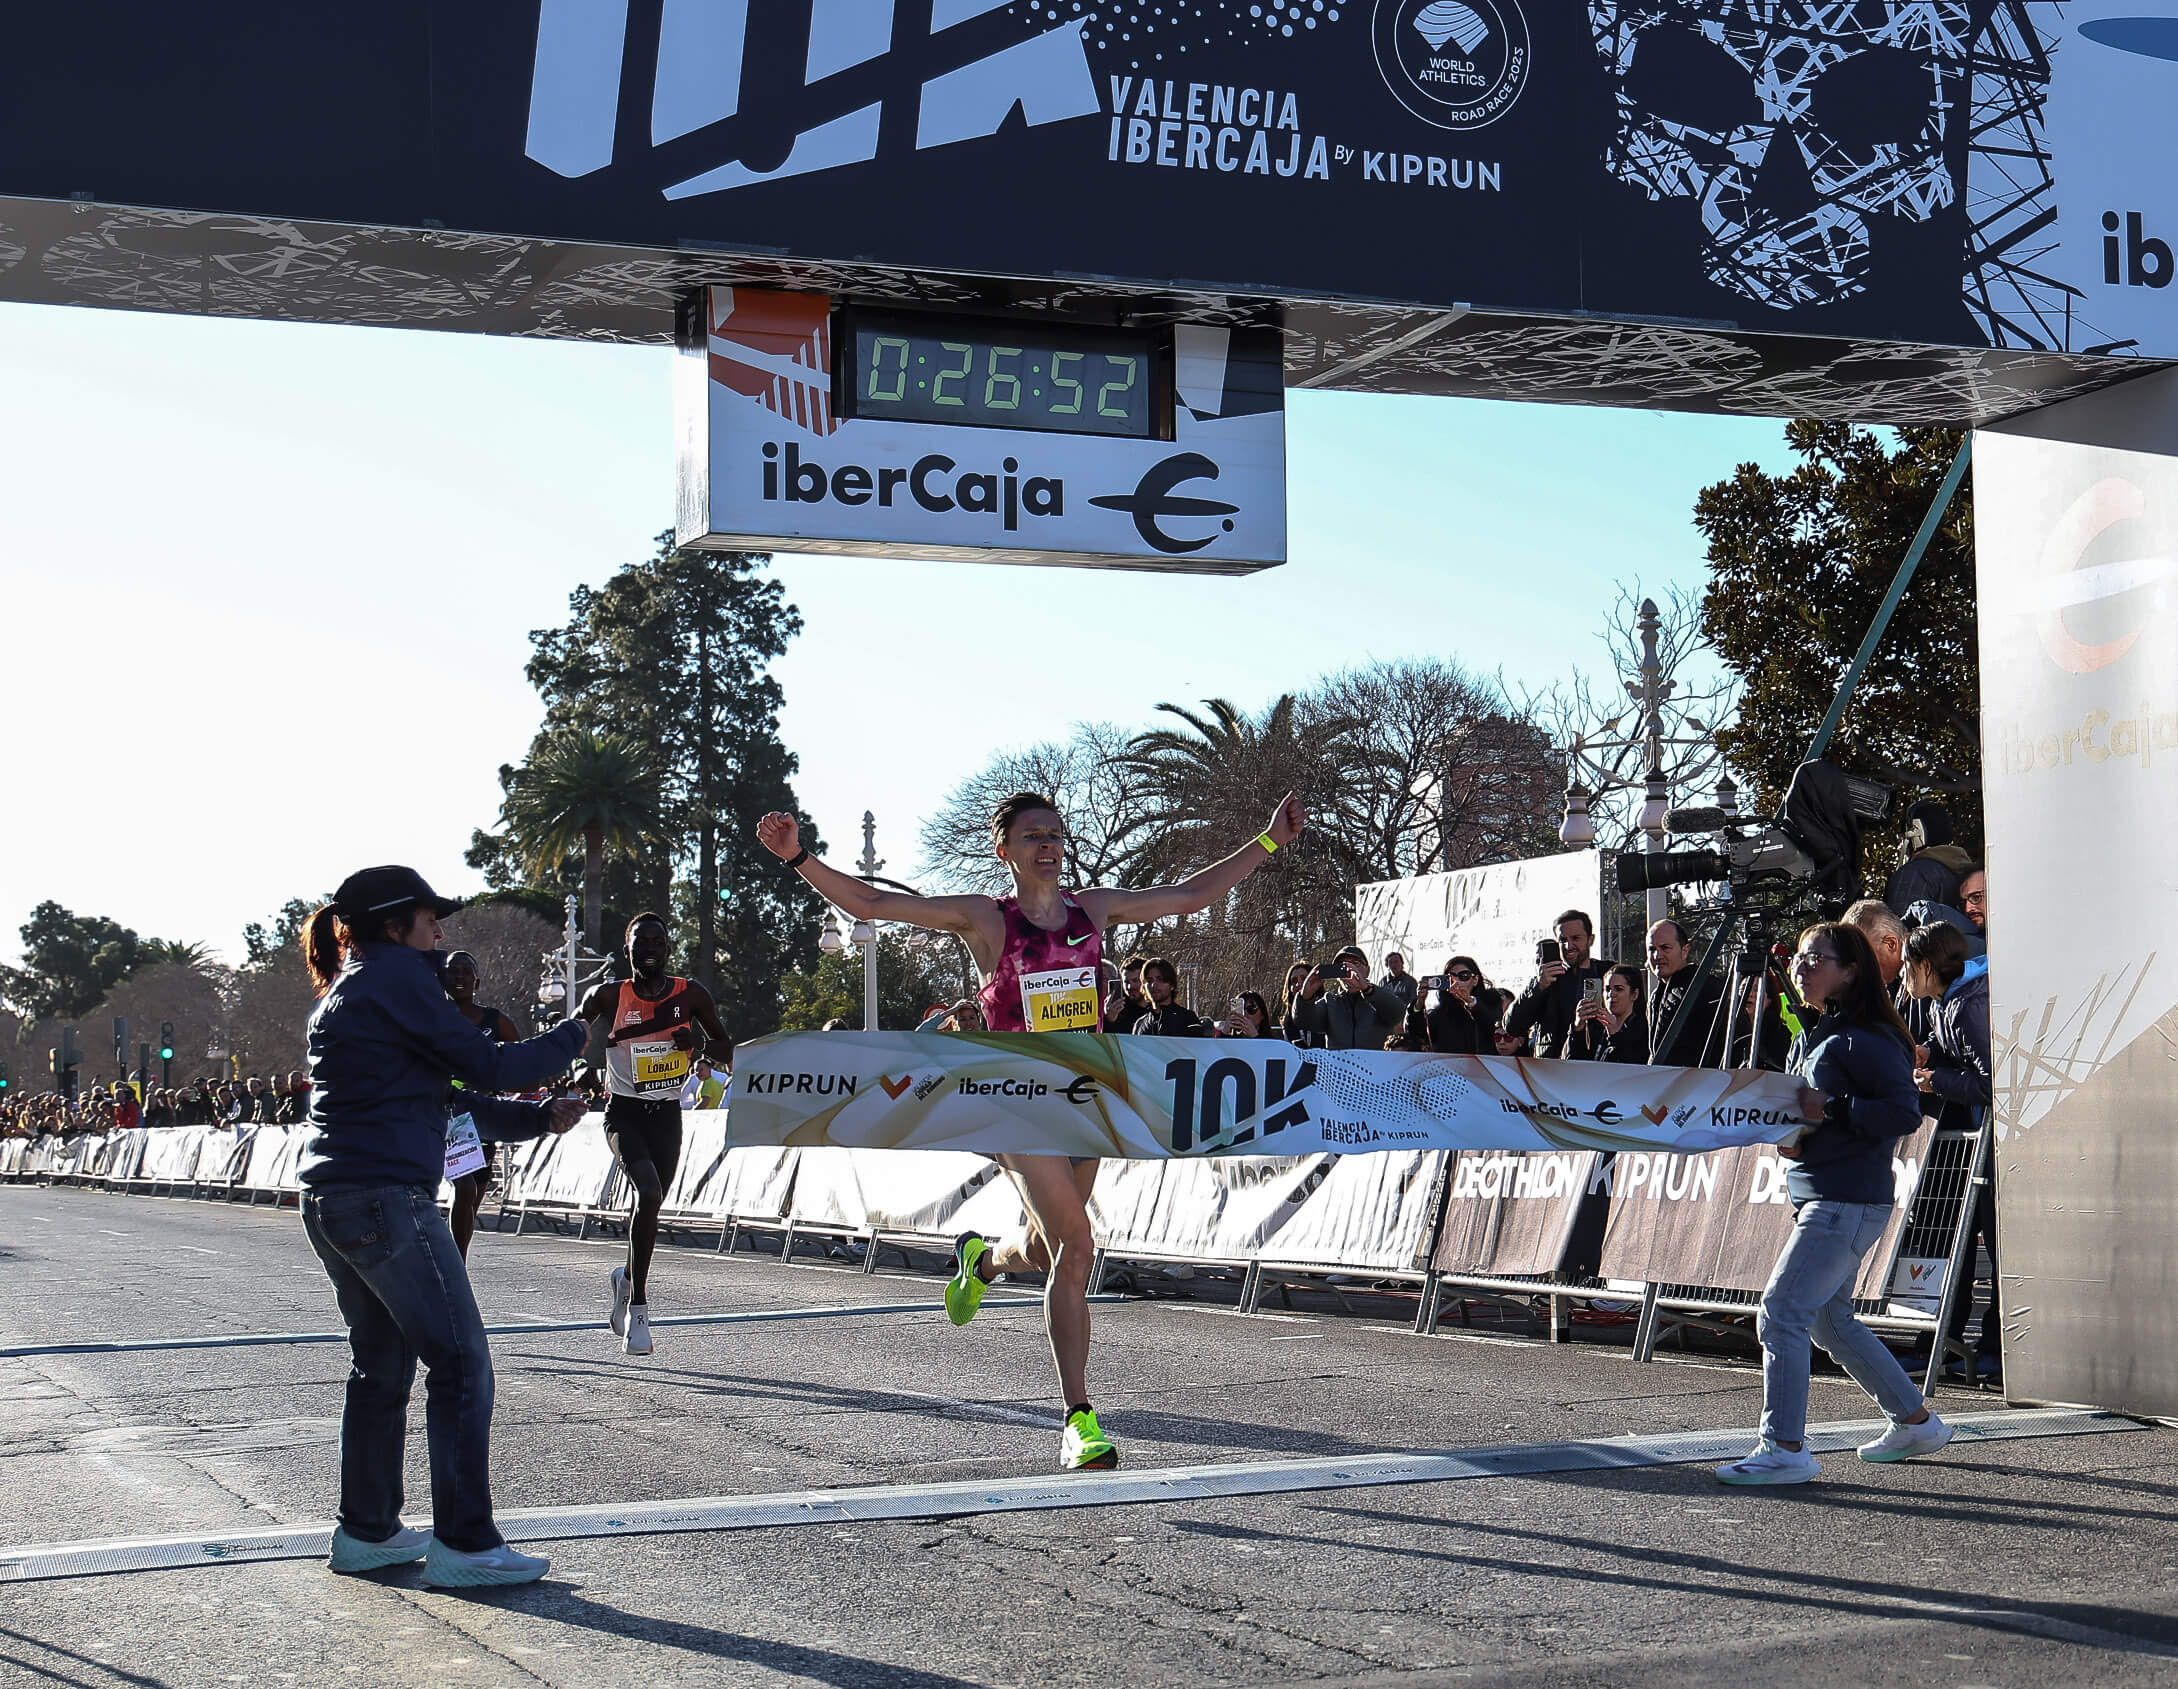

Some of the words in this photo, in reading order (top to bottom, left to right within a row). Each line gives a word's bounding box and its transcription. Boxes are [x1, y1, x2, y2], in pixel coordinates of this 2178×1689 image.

[1429, 57, 1475, 72] WORLD
[1419, 69, 1486, 87] ATHLETICS
[1451, 106, 1486, 121] ROAD
[1486, 82, 1513, 113] RACE
[1508, 46, 1524, 83] 2025
[1109, 74, 1299, 131] VALENCIA
[1108, 116, 1330, 181] IBERCAJA
[1334, 143, 1355, 165] By
[1363, 150, 1502, 193] KIPRUN
[868, 336, 1137, 419] 0:26:52
[761, 440, 1065, 533] iberCaja
[1023, 975, 1070, 991] iberCaja
[1041, 1000, 1093, 1020] ALMGREN
[1067, 1018, 1073, 1028] 2
[633, 1045, 667, 1055] iberCaja
[647, 1059, 680, 1074] LOBALU
[645, 1078, 680, 1091] KIPRUN
[747, 1073, 857, 1097] KIPRUN
[959, 1076, 1048, 1100] iberCaja
[1165, 1057, 1318, 1152] 10K
[1500, 1098, 1579, 1120] iberCaja
[1388, 1130, 1429, 1140] KIPRUN
[1588, 1151, 1721, 1201] KIPRUN
